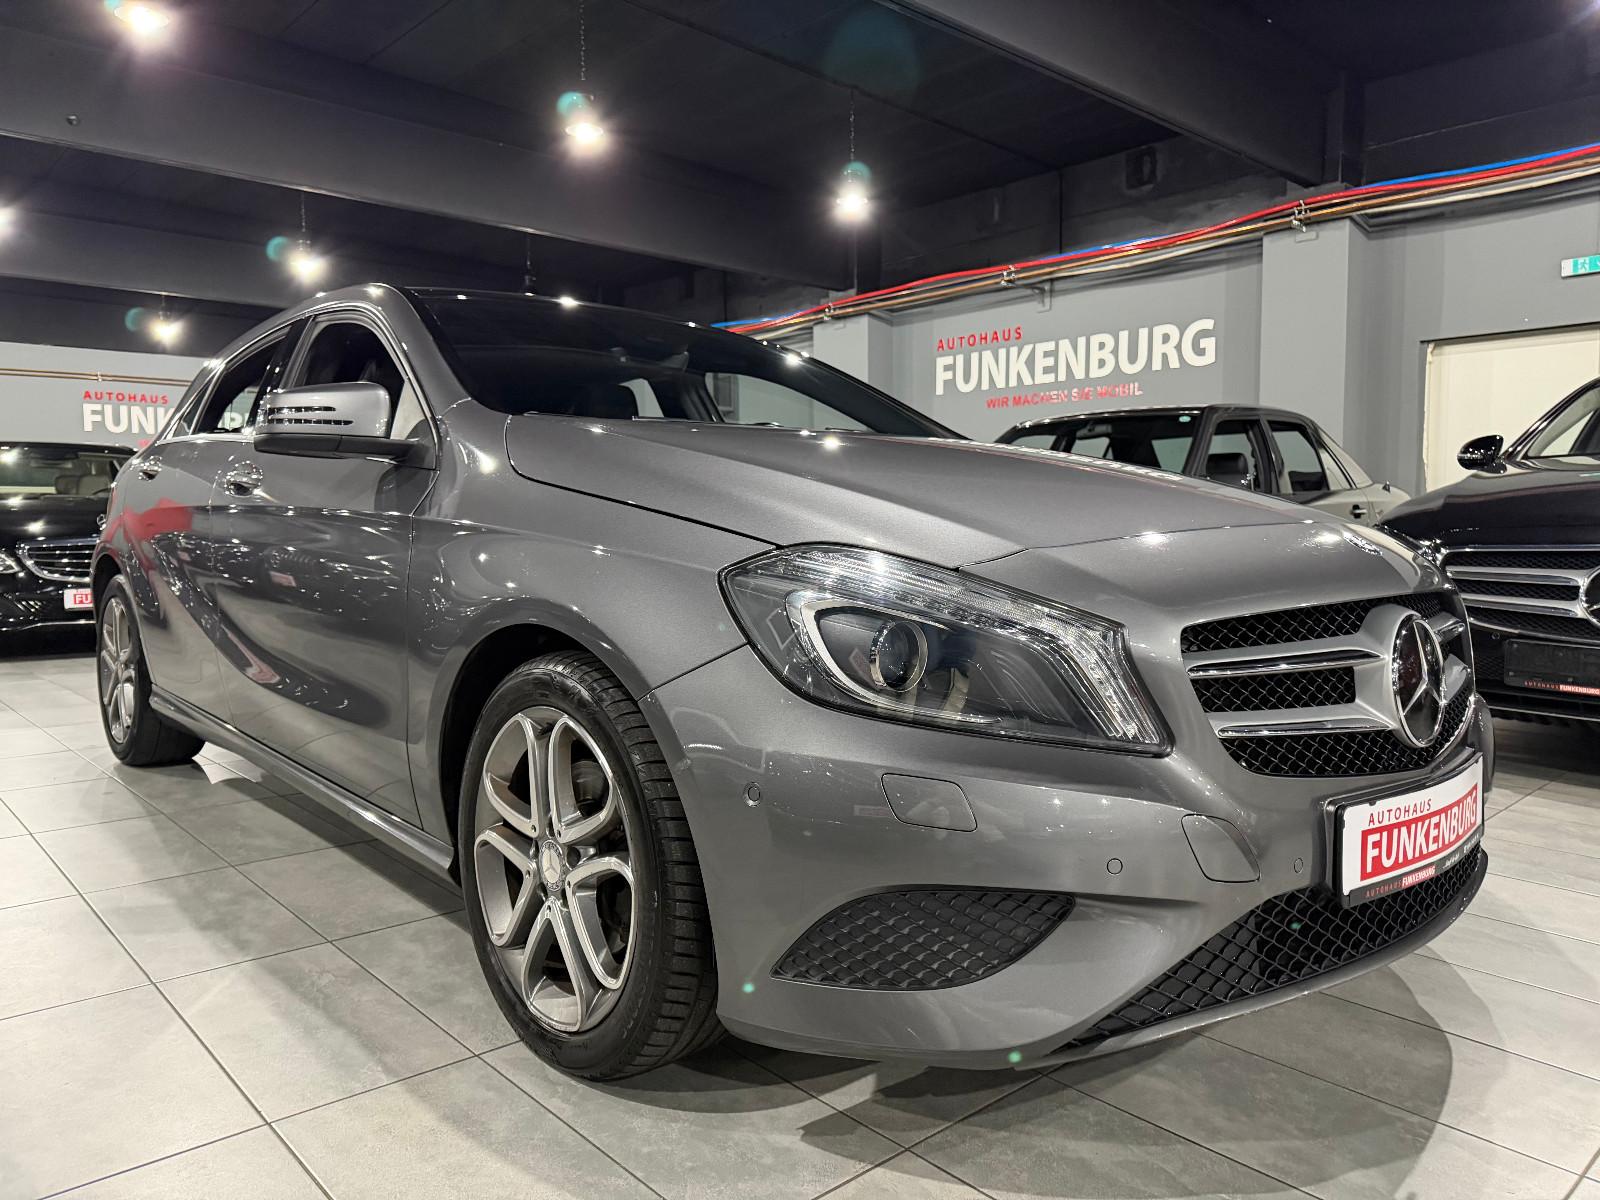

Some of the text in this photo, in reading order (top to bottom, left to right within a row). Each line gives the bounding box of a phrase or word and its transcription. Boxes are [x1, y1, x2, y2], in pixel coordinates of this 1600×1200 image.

[937, 326, 1022, 351] AUTOHAUS
[935, 318, 1216, 396] FUNKENBURG
[83, 390, 169, 404] AUTOHAUS
[986, 396, 1009, 408] WIR
[1097, 382, 1143, 398] MOBIL
[1368, 798, 1432, 826] AUTOHAUS
[1366, 789, 1477, 874] FUNKENBURG
[1366, 865, 1436, 898] AUTOHAUS FUNKENBURG
